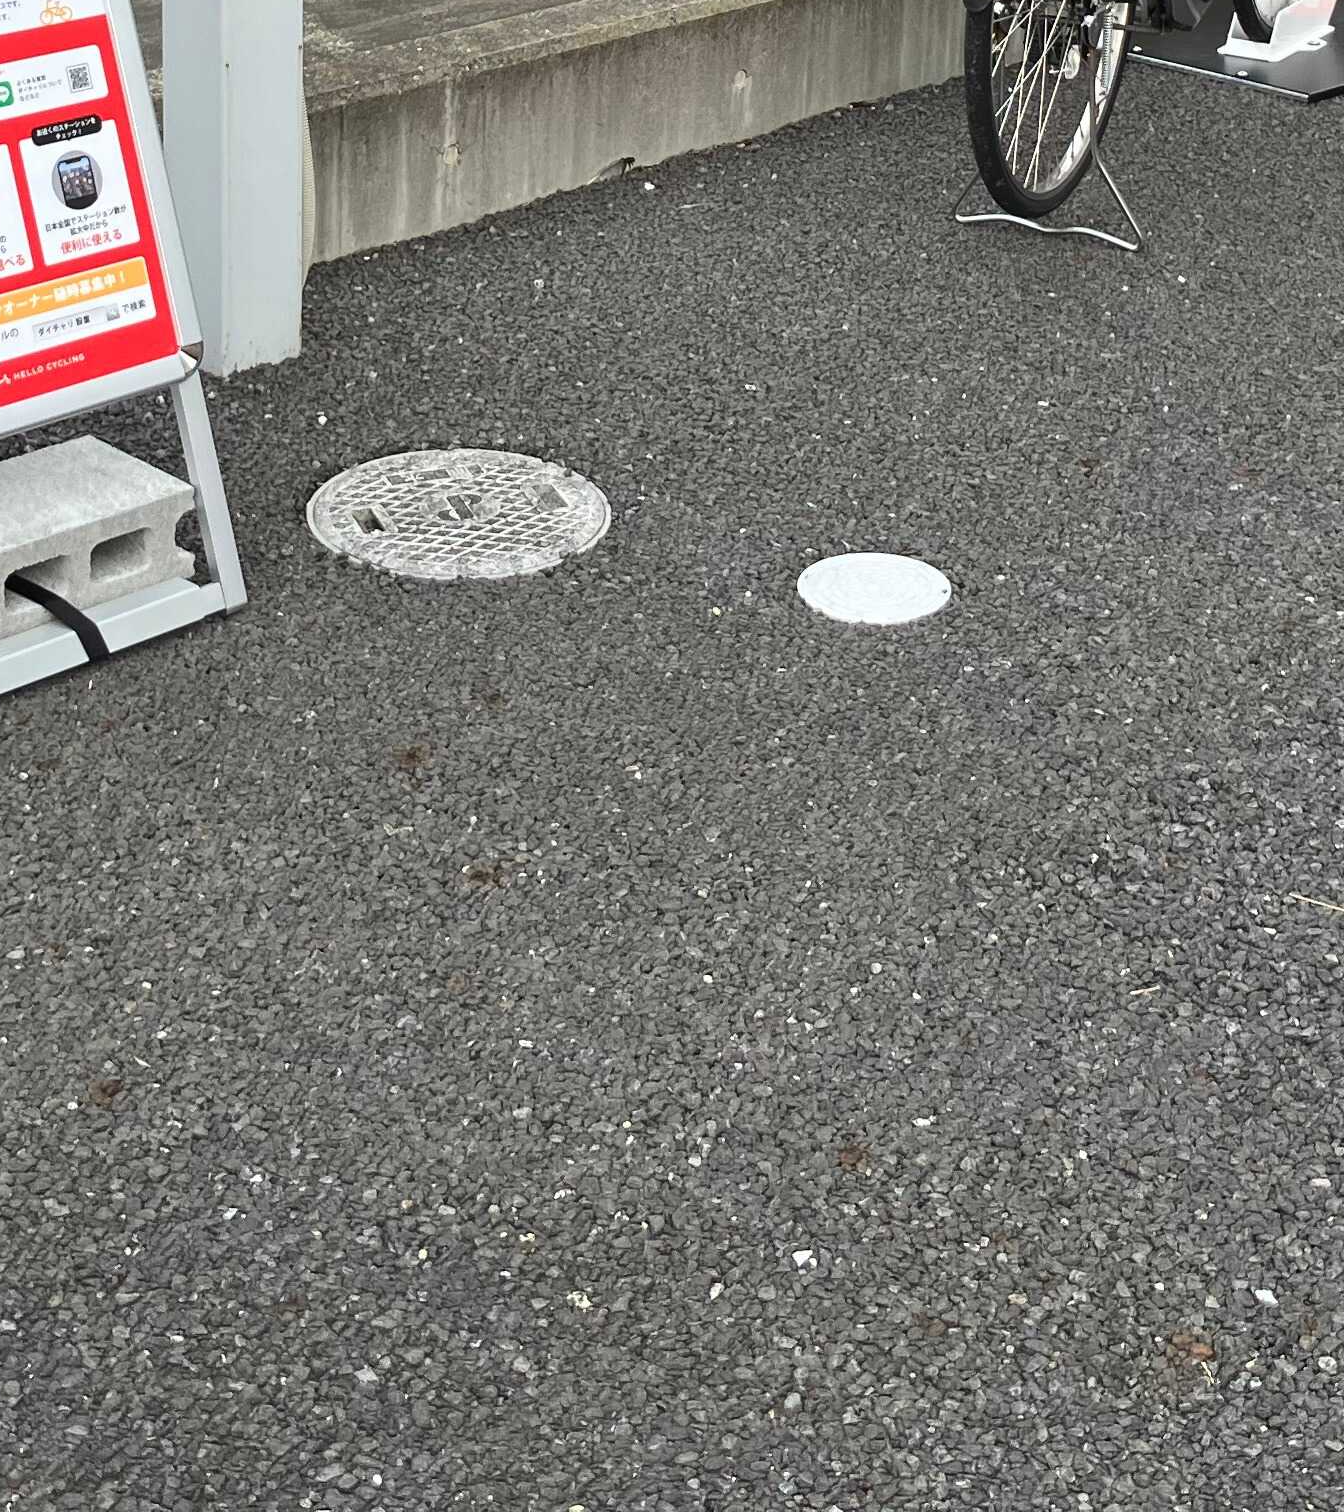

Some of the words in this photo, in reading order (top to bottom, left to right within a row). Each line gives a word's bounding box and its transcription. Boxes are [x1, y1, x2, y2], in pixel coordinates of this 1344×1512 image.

[44, 203, 127, 232] 日本全国でステーション数が
[69, 218, 108, 235] 拡大中だから
[60, 227, 122, 254] 便利に使える
[37, 319, 74, 337] ダイチャリ
[13, 365, 43, 381] HELLO
[45, 352, 85, 371] CYCLING
